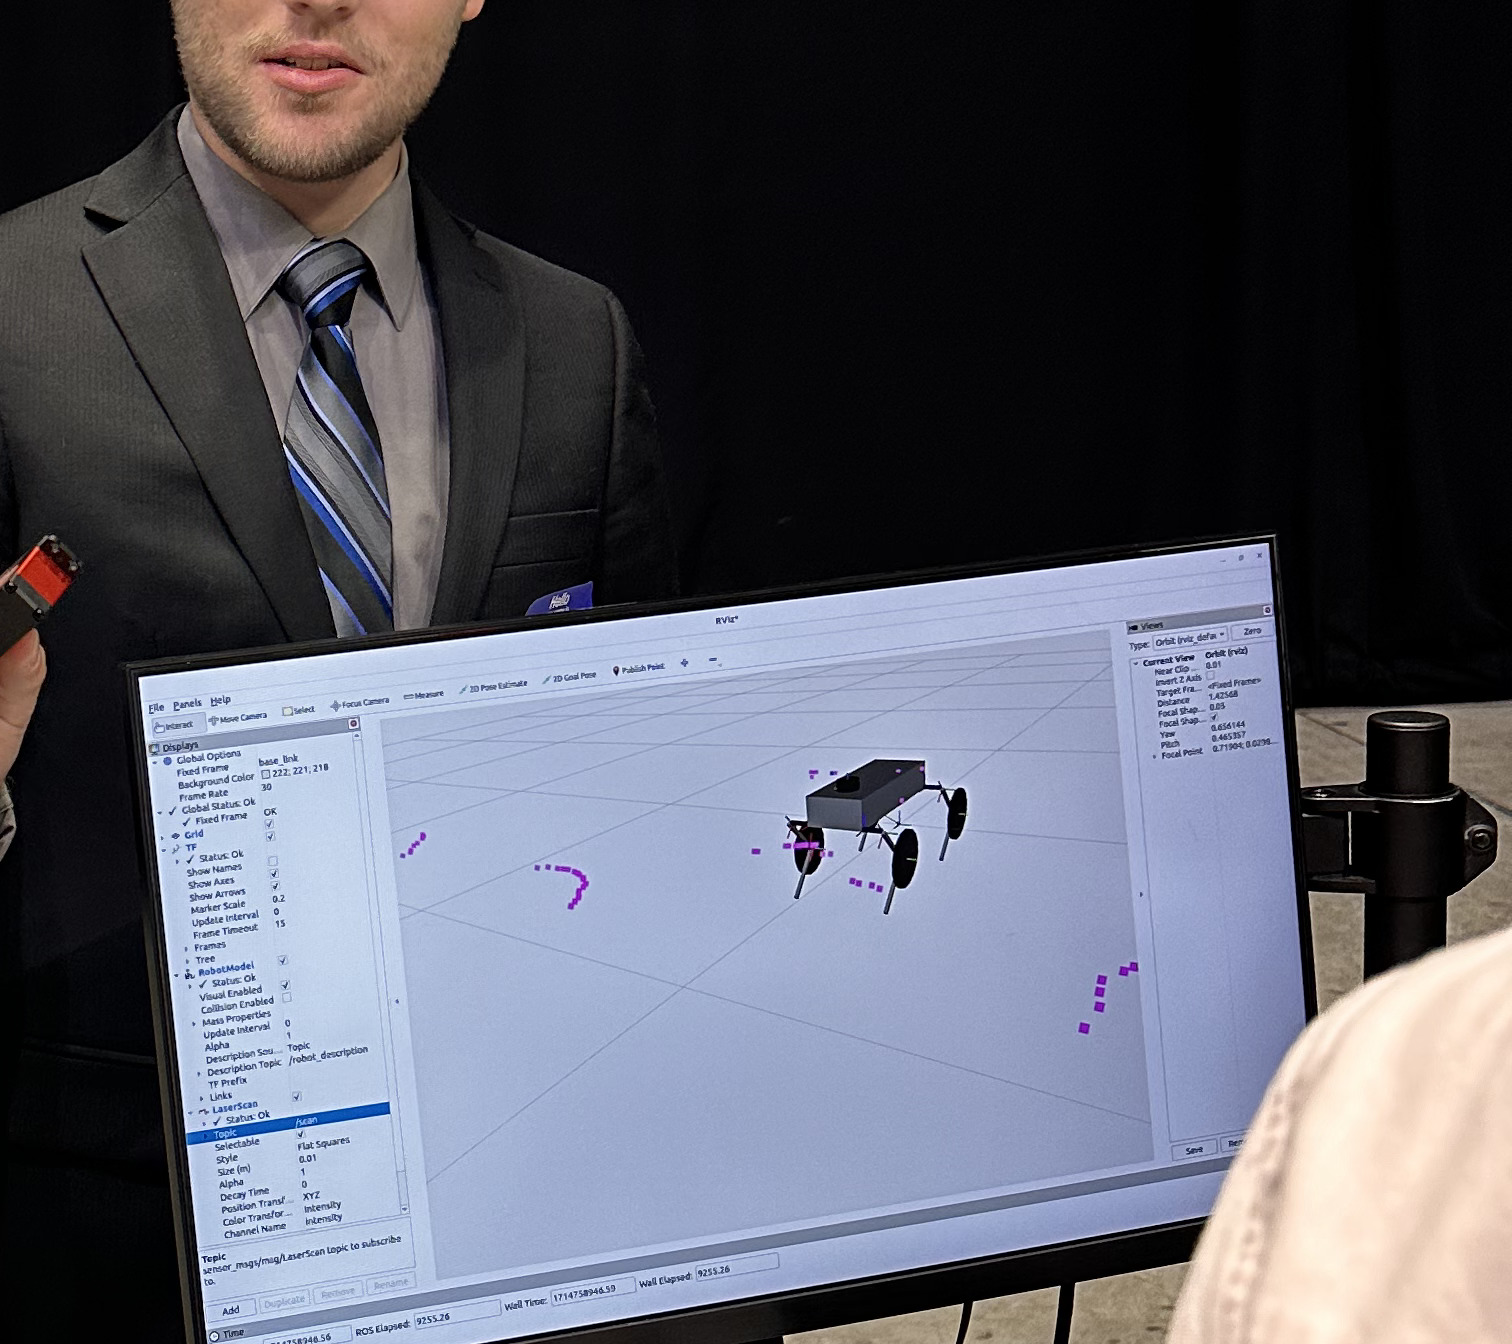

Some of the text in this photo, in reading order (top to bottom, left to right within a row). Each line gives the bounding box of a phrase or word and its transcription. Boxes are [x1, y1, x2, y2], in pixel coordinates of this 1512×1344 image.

[148, 695, 231, 714] File Panels Help
[162, 741, 198, 752] Displays
[176, 750, 241, 764] Global Options
[176, 765, 200, 777] Fixed
[201, 764, 229, 773] Frame
[178, 774, 229, 789] Background
[231, 772, 254, 782] Color
[179, 783, 272, 802] Frame Rate 30
[181, 802, 210, 814] Global
[243, 797, 256, 806] Ok
[195, 807, 277, 824] Fixed Frame OK
[184, 828, 203, 839] Grid
[185, 843, 197, 851] TF
[231, 849, 244, 858] Ok
[186, 867, 210, 877] Show
[187, 880, 211, 889] Show
[189, 888, 246, 902] Show Arrows
[190, 894, 285, 914] Marker Scale 0.2
[192, 907, 279, 927] Update Interval 0
[193, 919, 285, 939] Frame Timeout 15
[195, 955, 215, 964] Tree
[198, 960, 254, 976] RobotModel
[198, 984, 262, 1001] Visual Enabled
[239, 995, 274, 1008] Enabled
[204, 1041, 229, 1052] Alpha
[221, 1075, 247, 1087] Prefix
[209, 1091, 232, 1101] Links
[212, 1101, 258, 1113] LaserScan
[214, 1137, 259, 1151] Selectable
[216, 1136, 350, 1164] Style Flat Squares
[220, 1191, 246, 1201] Decay
[247, 1187, 269, 1196] Time
[222, 1304, 239, 1316] Add
[222, 1329, 244, 1338] Time
[355, 1326, 374, 1336] ROS
